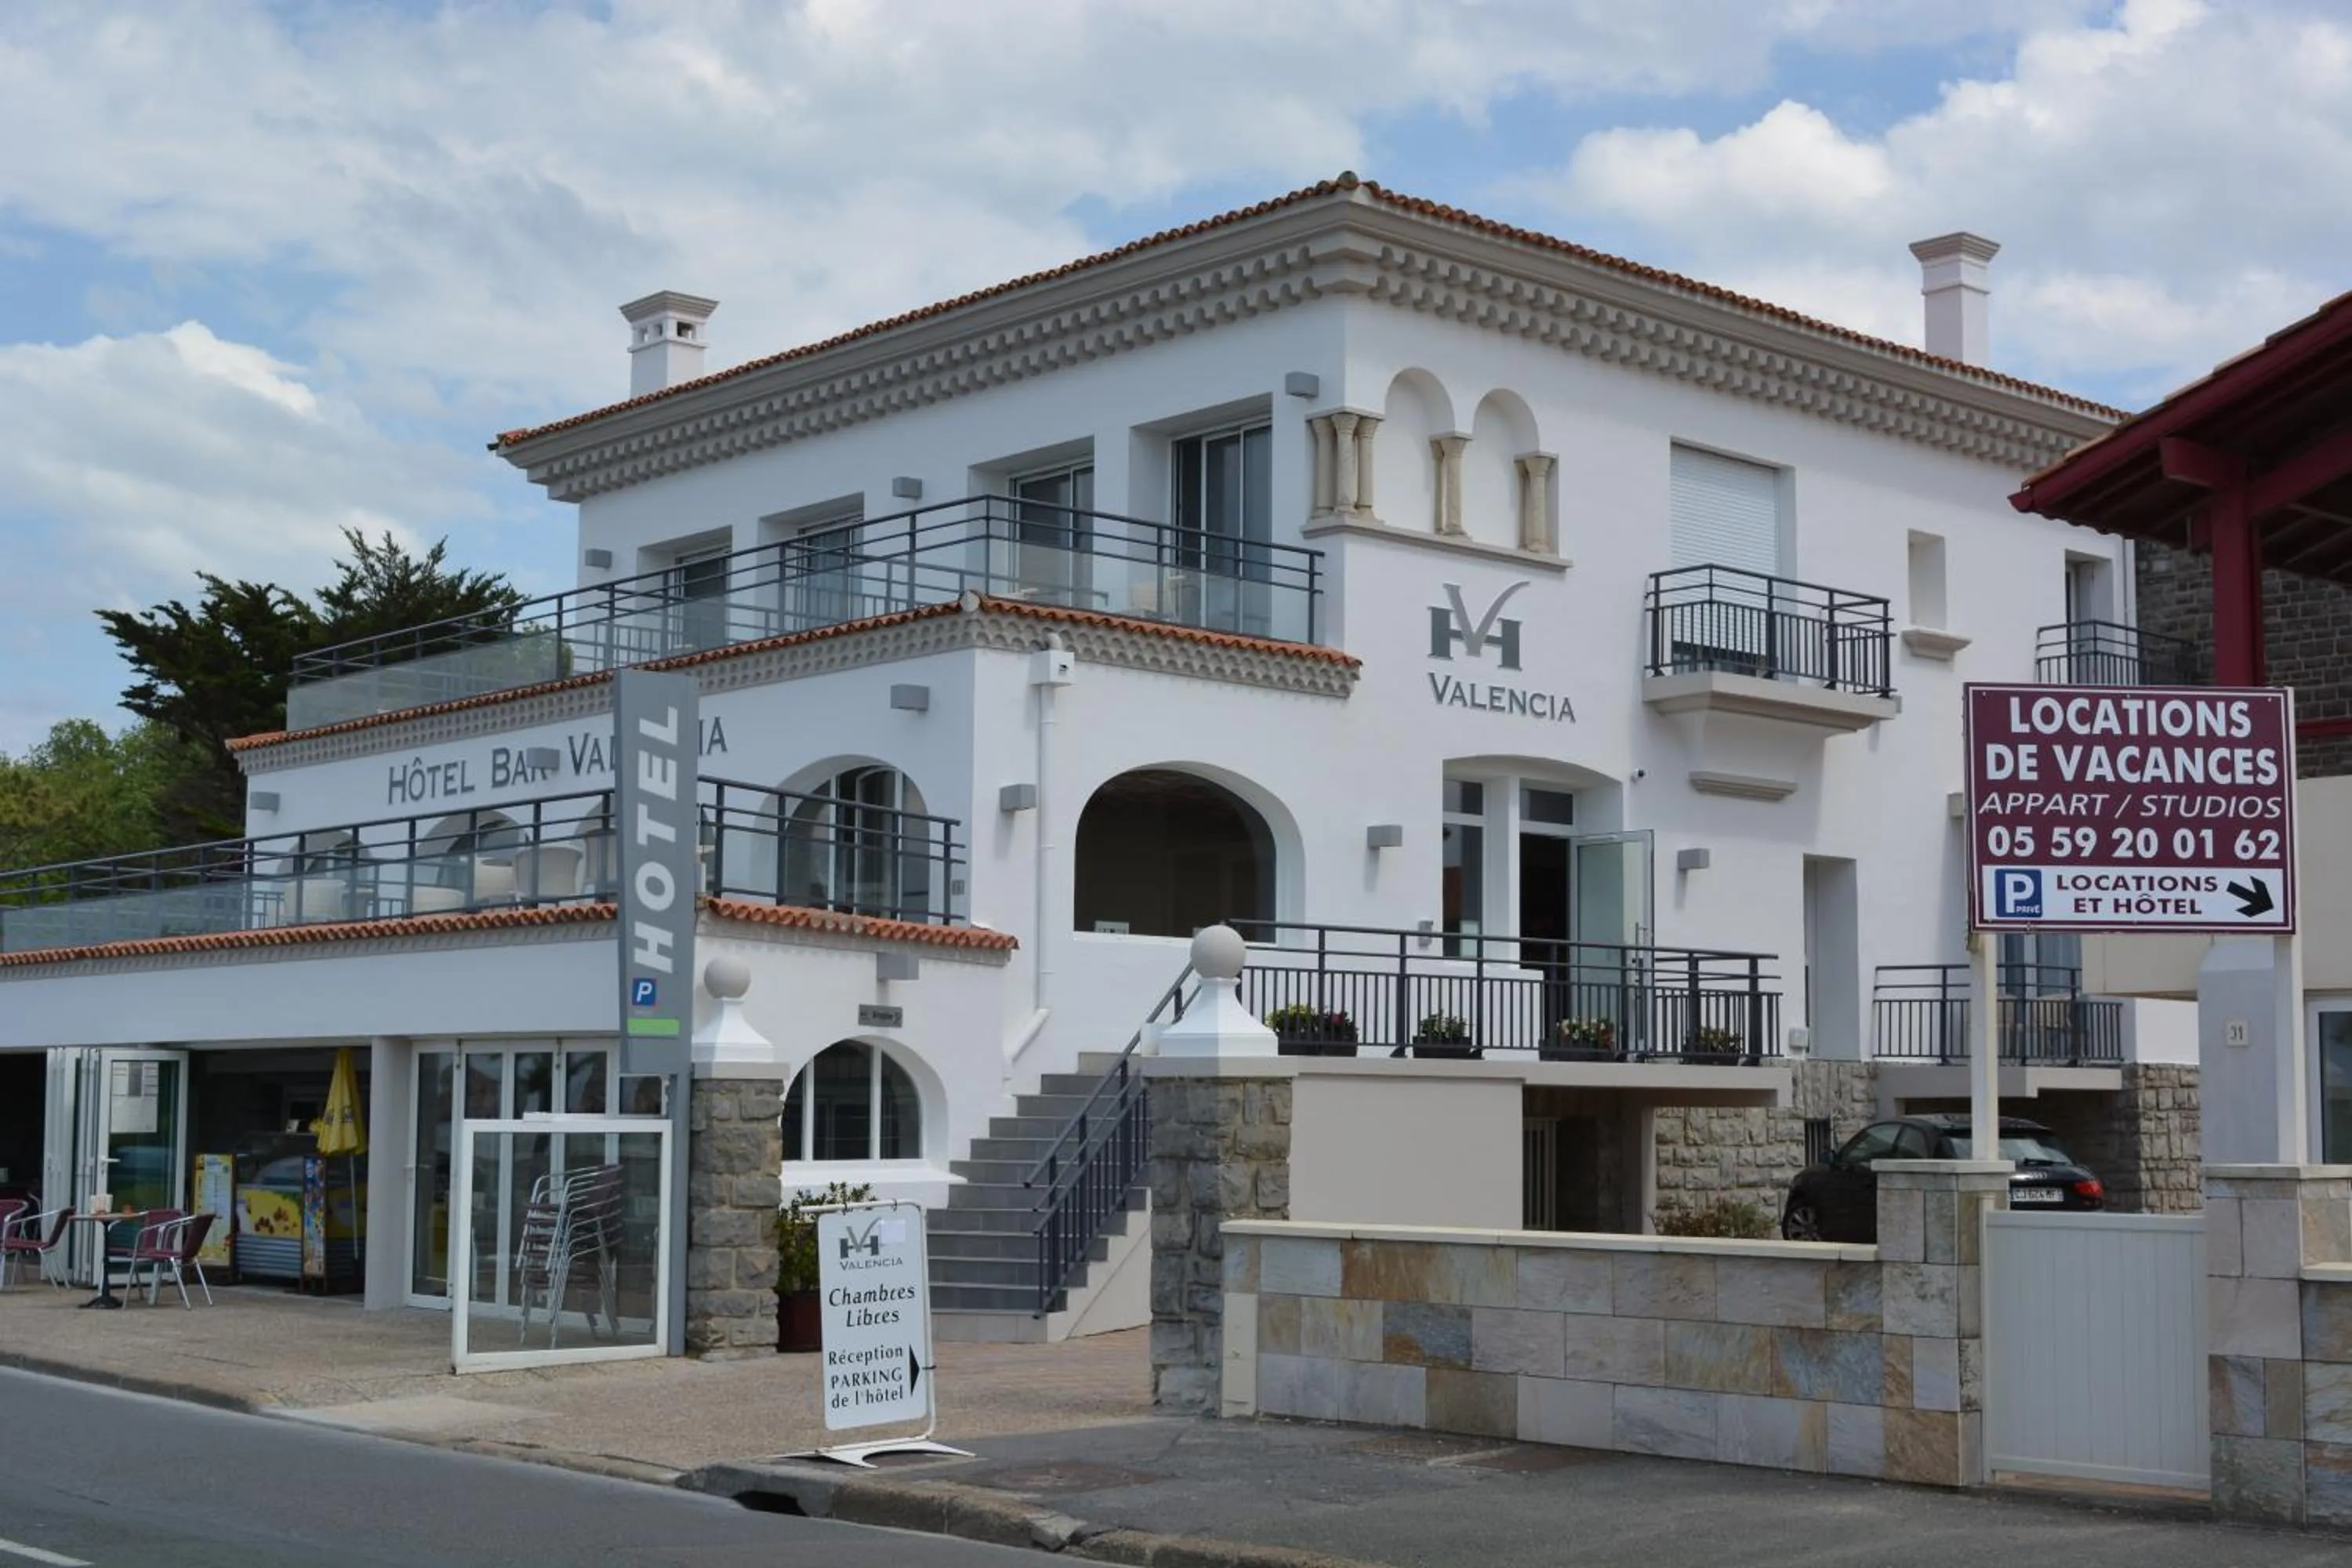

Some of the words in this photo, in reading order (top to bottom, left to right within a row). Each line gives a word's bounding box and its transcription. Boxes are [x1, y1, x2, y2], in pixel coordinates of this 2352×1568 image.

[1427, 672, 1577, 723] VALENCIA
[2009, 696, 2252, 738] LOCATIONS
[1986, 743, 2038, 781] DE
[2053, 745, 2278, 785] VACANCES
[388, 757, 475, 805] HÔTEL
[1979, 792, 2109, 815] APPART
[2140, 795, 2282, 818] STUDIOS
[633, 705, 678, 974] HOTEL
[1987, 826, 2034, 857] 05
[2050, 826, 2097, 858] 59
[2111, 827, 2158, 858] 20
[2173, 828, 2214, 859] 01
[2234, 829, 2281, 861] 62
[2005, 873, 2034, 913] P
[2056, 874, 2218, 892] LOCATIONS
[2074, 898, 2103, 913] ET
[2114, 893, 2201, 914] HÔTEL
[636, 982, 653, 1003] P
[840, 1257, 903, 1270] VALENCIA
[829, 1283, 916, 1307] Chambres
[847, 1307, 900, 1327] Libres
[829, 1345, 903, 1366] Réception
[831, 1367, 902, 1389] PARKING
[831, 1392, 849, 1409] de
